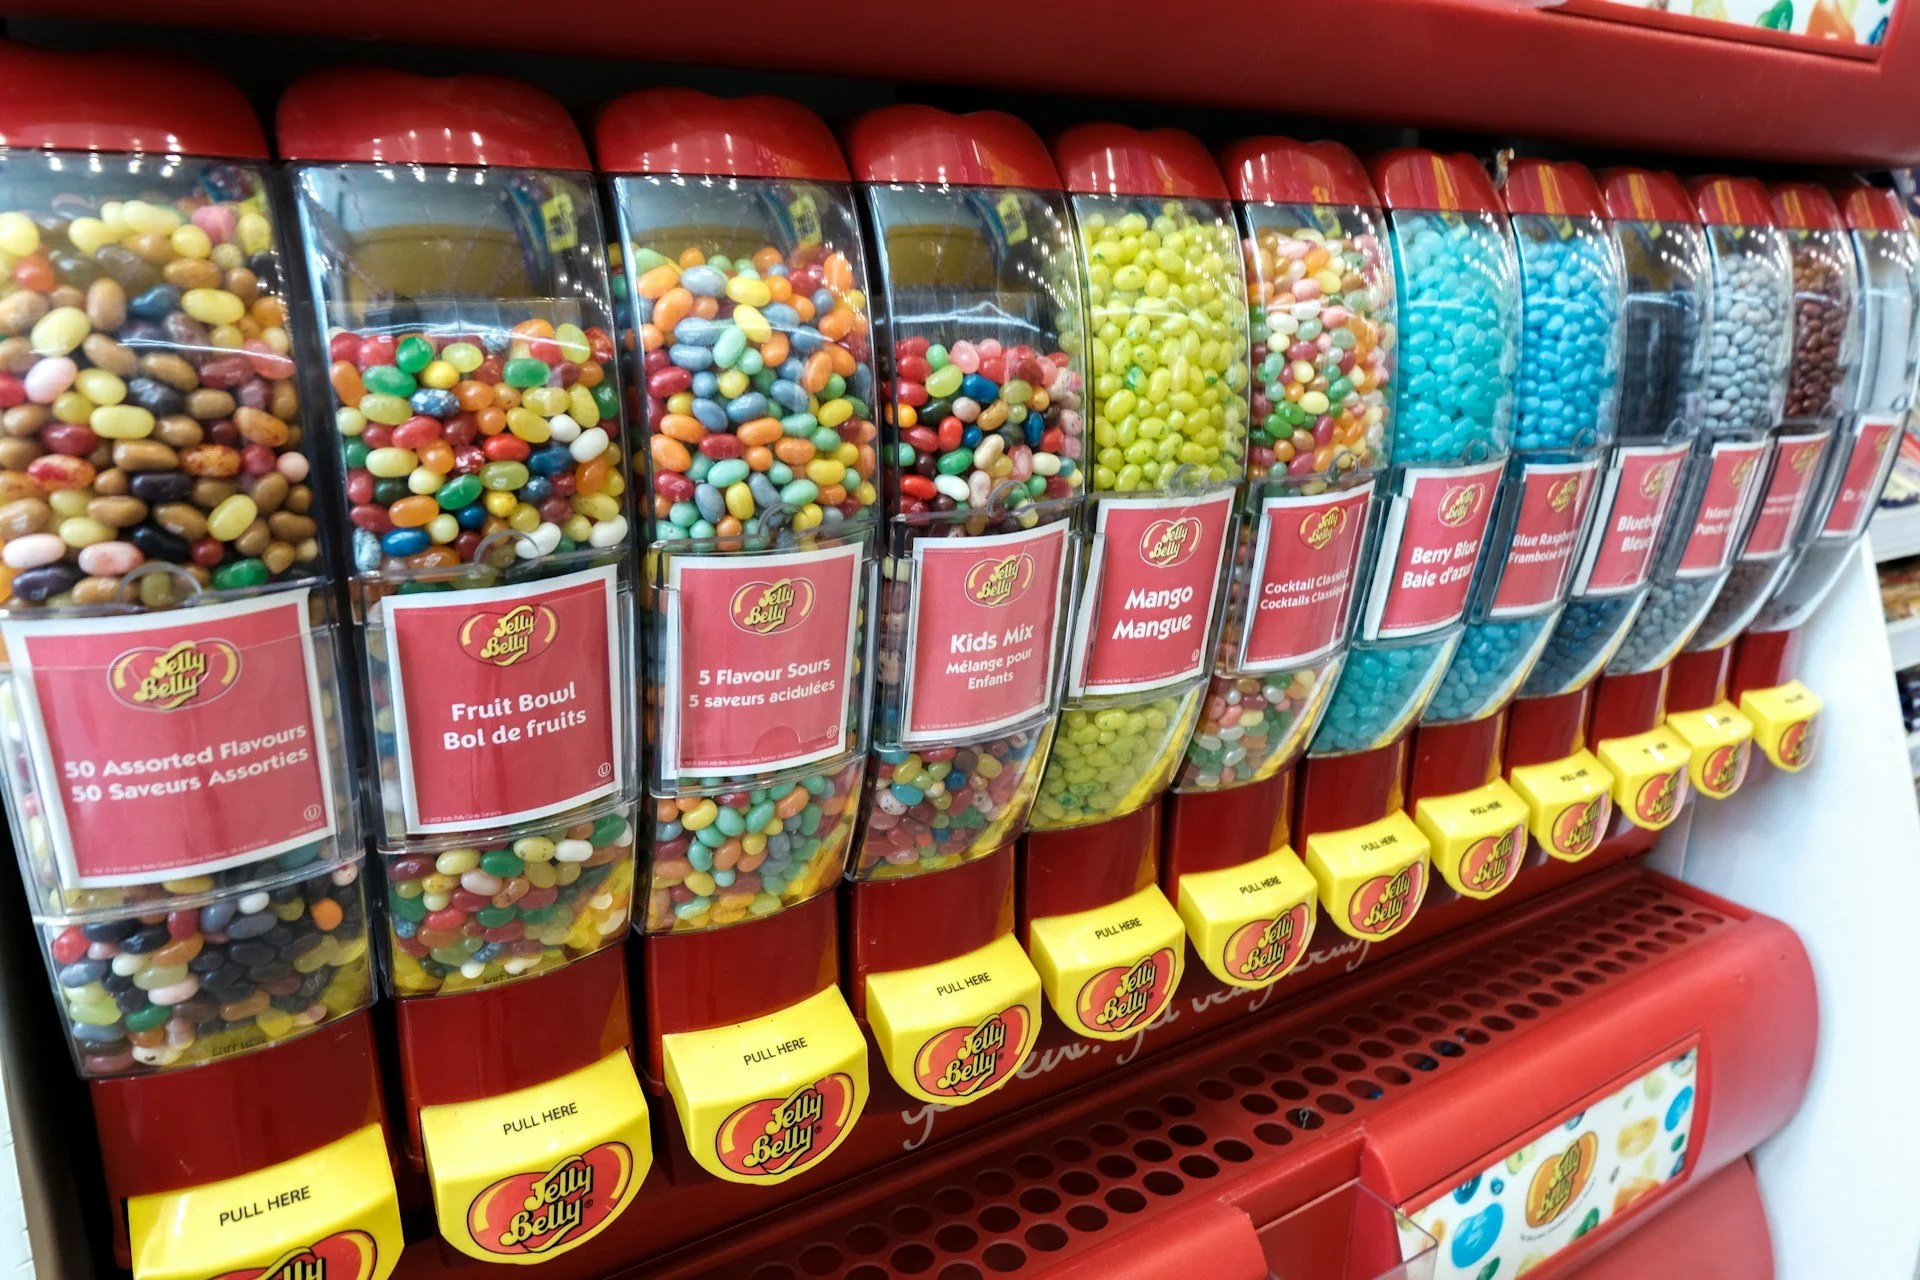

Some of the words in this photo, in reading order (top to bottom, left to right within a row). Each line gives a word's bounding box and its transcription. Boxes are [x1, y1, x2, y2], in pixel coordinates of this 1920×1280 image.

[1162, 521, 1189, 543] Jelly
[1318, 509, 1338, 530] Jelly
[1149, 542, 1180, 562] Belly
[1308, 529, 1333, 546] Belly
[1411, 545, 1452, 566] Berry
[1454, 539, 1477, 559] Blue
[1512, 533, 1538, 547] Blue
[990, 559, 1020, 582] Jelly
[1401, 569, 1436, 589] Baie
[1439, 561, 1473, 585] d'azur
[758, 582, 795, 607] Jelly
[976, 581, 1012, 602] Belly
[1124, 585, 1193, 610] Mango
[1265, 577, 1314, 595] Cocktail
[1260, 594, 1310, 610] Cocktails
[494, 607, 534, 638] Jelly
[744, 606, 786, 629] Belly
[1112, 613, 1193, 640] Mangue
[480, 635, 528, 662] Belly
[951, 631, 997, 654] Kids
[1002, 623, 1034, 647] Mix
[152, 644, 207, 679] Jelly
[698, 670, 710, 686] 5
[717, 666, 782, 685] Flavour
[788, 658, 831, 676] Sours
[946, 656, 1003, 675] Mélange
[1006, 648, 1032, 672] pour
[133, 673, 200, 705] Belly
[689, 694, 699, 708] 5
[704, 694, 764, 708] saveurs
[769, 678, 835, 703] acidulées
[967, 671, 1014, 690] Enfants
[452, 698, 512, 722] Fruit
[519, 682, 576, 710] Bowl
[443, 729, 485, 751] Bol
[492, 725, 521, 745] de
[527, 709, 587, 738] fruits
[65, 760, 95, 779] 50
[103, 747, 213, 777] Assorted
[220, 725, 307, 759] Flavours
[72, 785, 102, 803] 50
[109, 778, 200, 801] Saveurs
[207, 747, 309, 786] Assorties
[1487, 831, 1514, 862] Jelly
[1239, 883, 1262, 895] PULL
[1261, 876, 1282, 889] HERE
[1379, 869, 1410, 904] Jelly
[1472, 858, 1507, 888] Belly
[1095, 925, 1119, 939] PULL
[1120, 917, 1142, 932] HERE
[1362, 899, 1404, 930] Belly
[1257, 912, 1294, 949] Jelly
[1240, 943, 1286, 977] Belly
[937, 982, 964, 996] PULL
[966, 972, 991, 987] HERE
[1115, 958, 1156, 998] Jelly
[1096, 991, 1148, 1028] Belly
[743, 1048, 776, 1066] PULL
[776, 1037, 808, 1056] HERE
[957, 1016, 1006, 1060] Jelly
[937, 1052, 996, 1092] Belly
[503, 1116, 540, 1135] PULL
[542, 1102, 579, 1123] HERE
[765, 1086, 822, 1135] Jelly
[742, 1125, 813, 1170] Belly
[524, 1157, 593, 1210] Jelly
[219, 1202, 264, 1227] PULL
[267, 1186, 311, 1211] HERE
[499, 1197, 583, 1248] Belly
